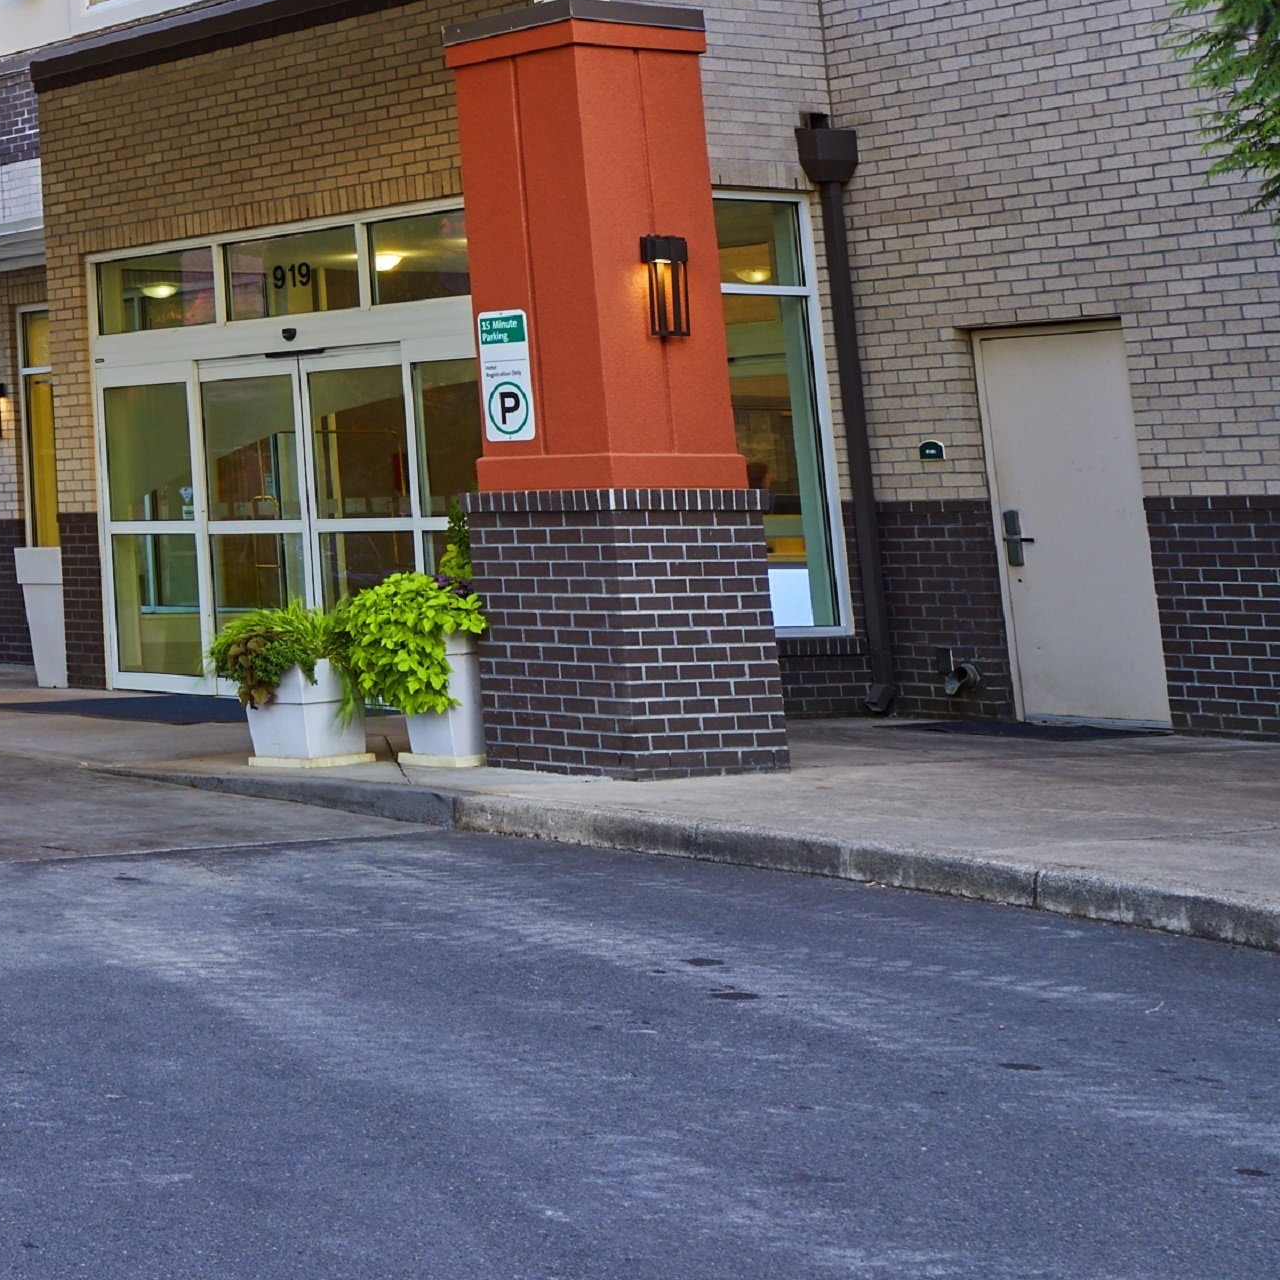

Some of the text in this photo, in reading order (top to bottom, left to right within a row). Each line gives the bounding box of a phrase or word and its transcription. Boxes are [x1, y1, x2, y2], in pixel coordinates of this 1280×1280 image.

[273, 262, 311, 289] 919
[481, 319, 518, 330] 15 Minute
[482, 331, 509, 343] Parking
[499, 391, 520, 425] P
